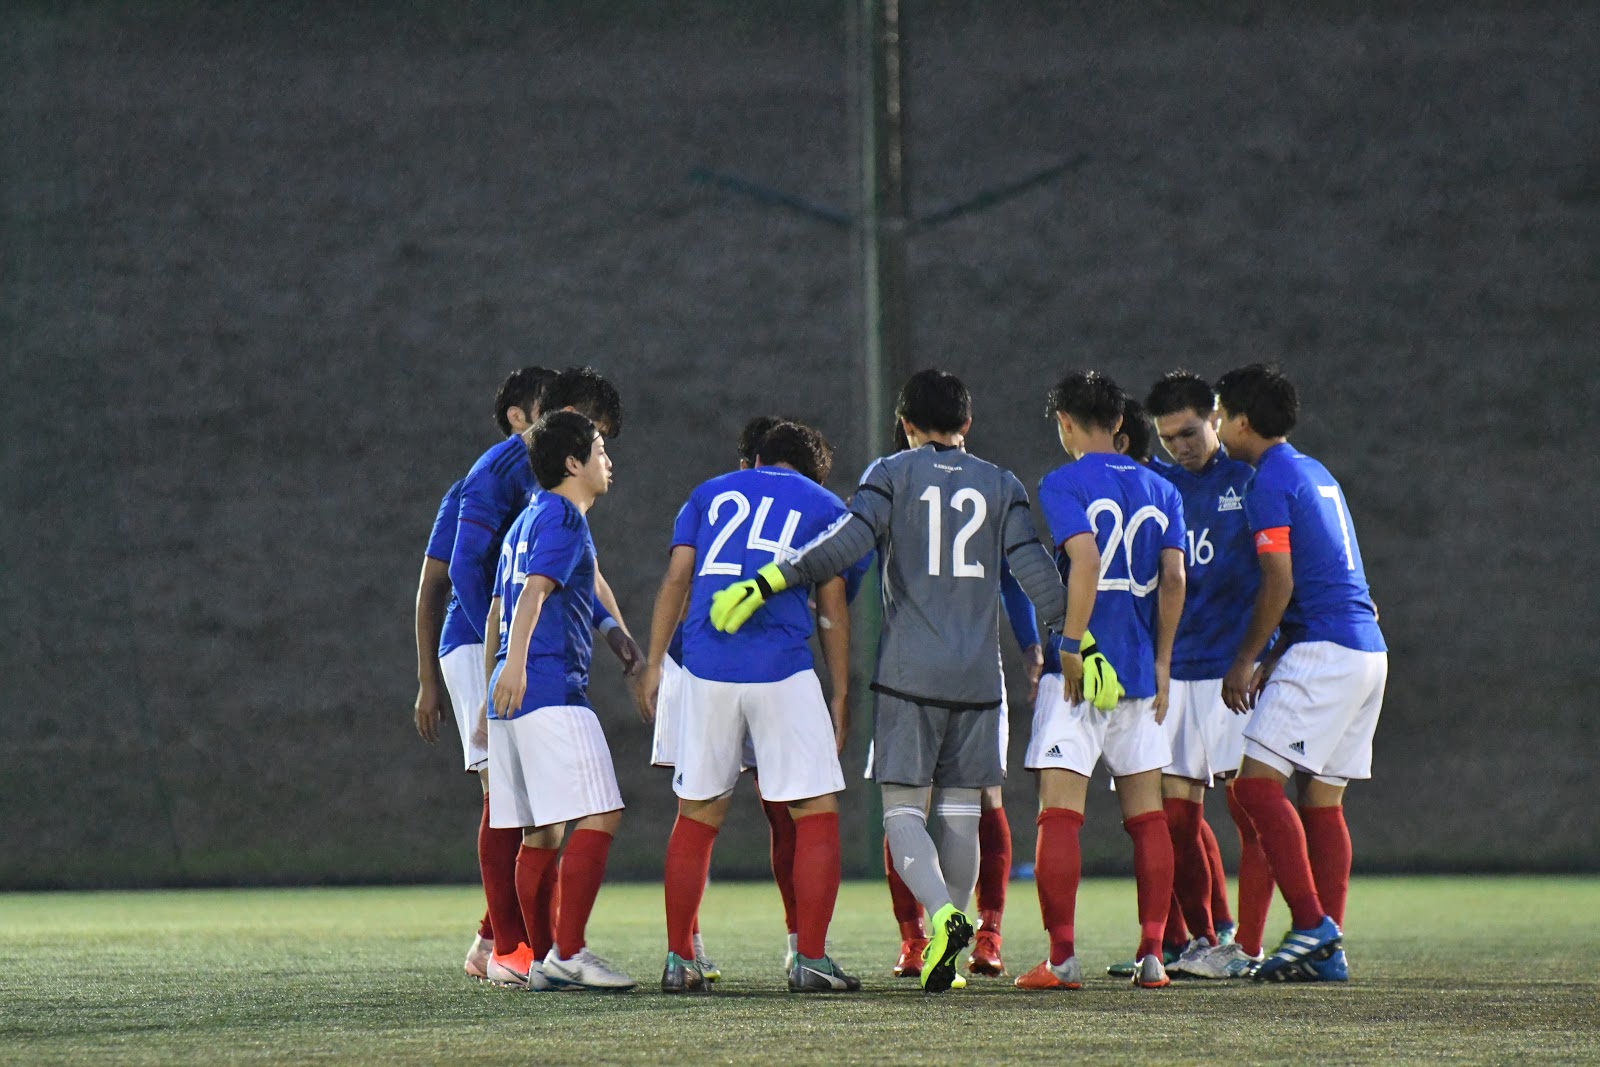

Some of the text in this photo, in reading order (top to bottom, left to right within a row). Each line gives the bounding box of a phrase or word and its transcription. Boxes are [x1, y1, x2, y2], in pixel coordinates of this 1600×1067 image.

[698, 490, 802, 577] 24
[919, 485, 987, 579] 12
[1086, 497, 1170, 597] 20
[1187, 528, 1214, 567] 16
[1317, 485, 1355, 571] 7
